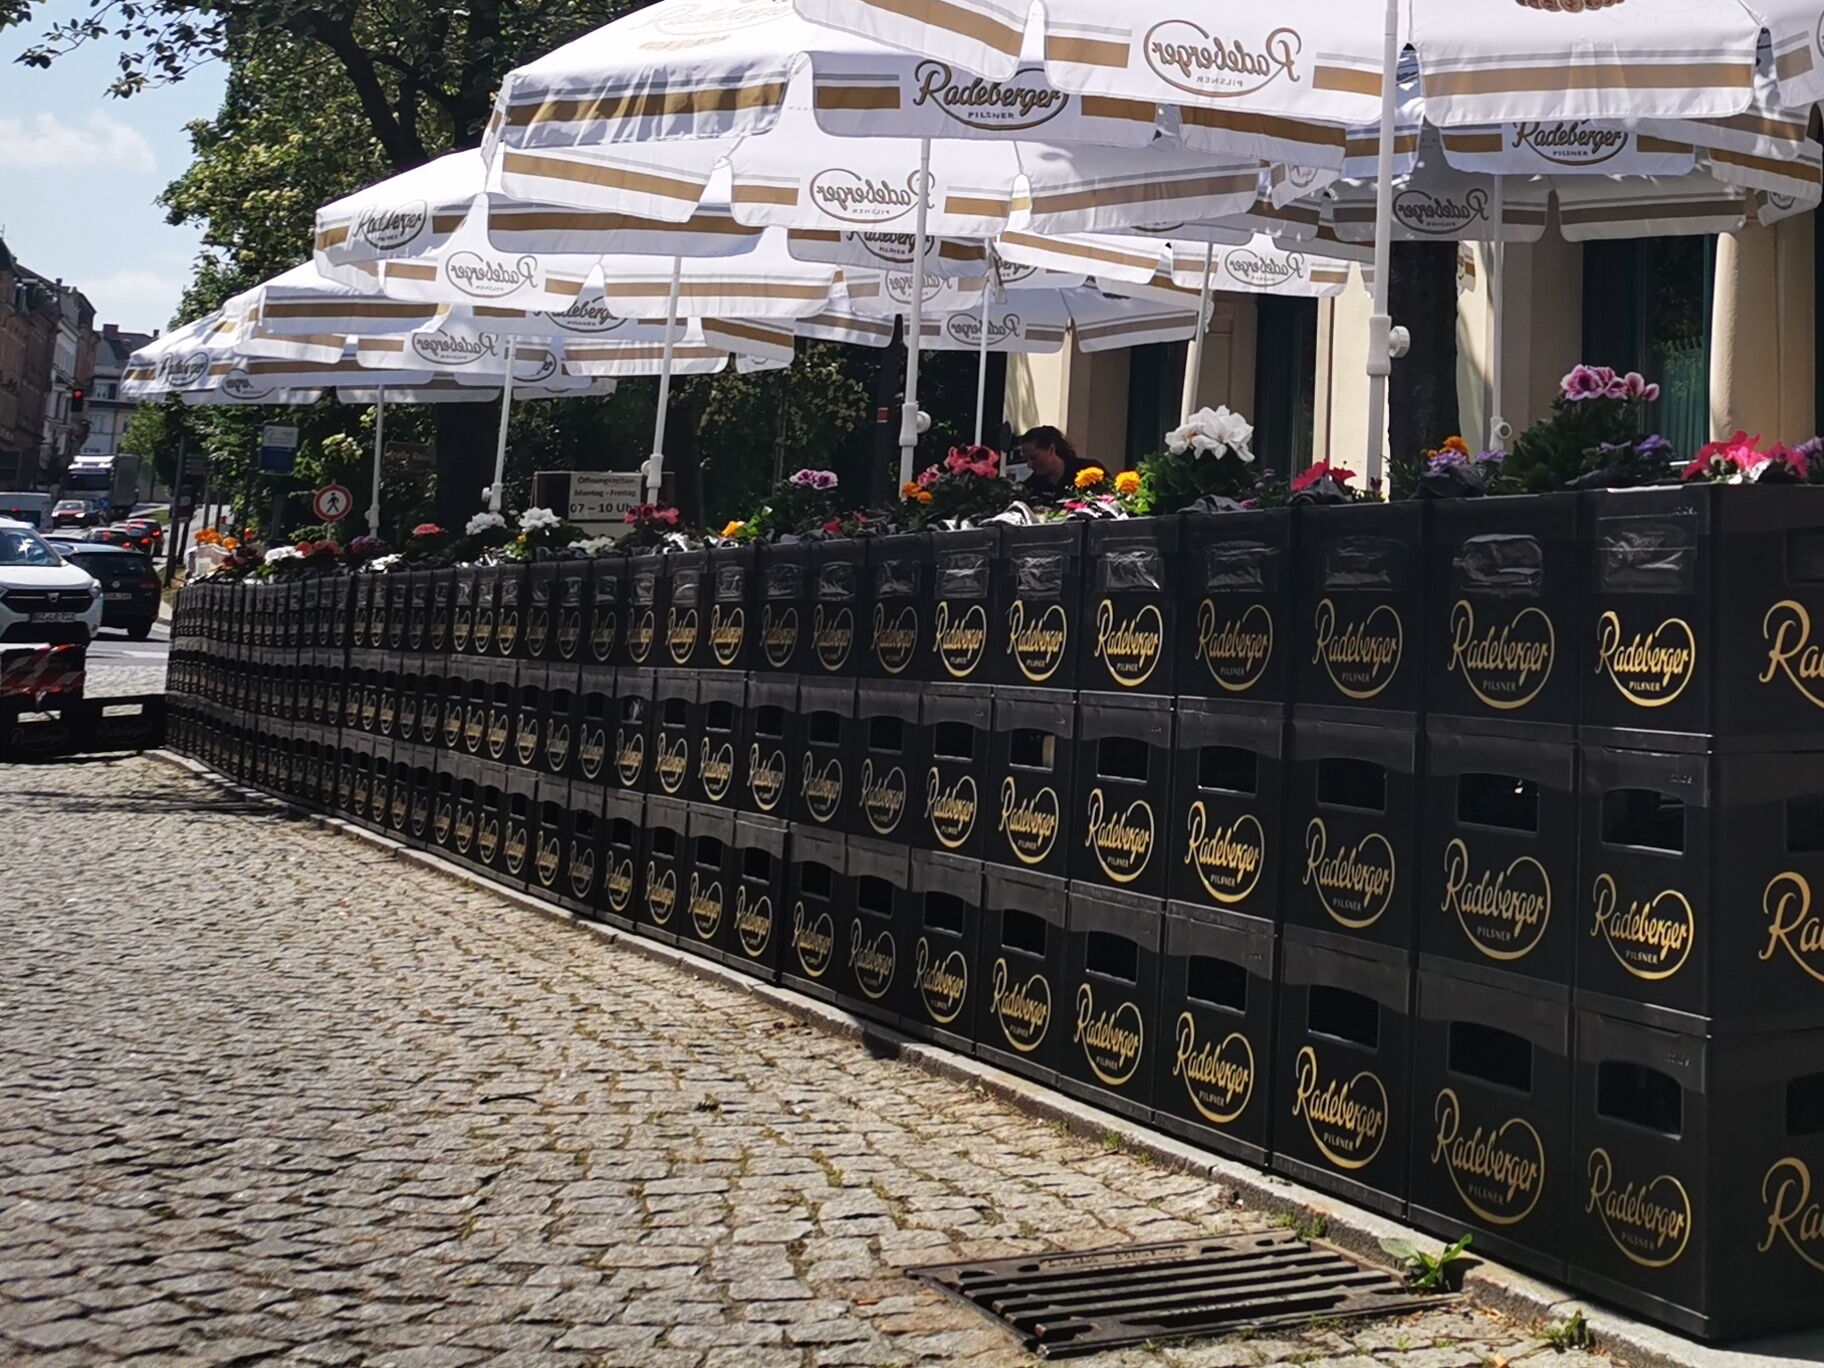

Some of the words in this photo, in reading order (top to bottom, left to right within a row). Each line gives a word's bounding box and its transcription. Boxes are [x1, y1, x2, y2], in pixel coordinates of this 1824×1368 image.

[913, 59, 1061, 117] Radeberger
[968, 111, 1015, 120] PILSNER
[570, 503, 585, 513] 07
[599, 503, 613, 513] 10
[1094, 599, 1160, 669] Radeberger
[1194, 598, 1269, 673] Radeberger
[1311, 598, 1398, 679] Radeberger
[1446, 598, 1549, 688] Radeberger
[1595, 610, 1690, 688] Radeberger
[1482, 680, 1516, 691] PILSNER
[1628, 681, 1660, 690] PILSNER
[1084, 788, 1151, 865] Radeberger
[1184, 800, 1261, 884] Radeberger
[1302, 817, 1390, 909] Radeberger
[1440, 837, 1545, 939] Radeberger
[1590, 872, 1688, 962] Radeberger
[1476, 925, 1511, 941] PILSNER
[1625, 949, 1658, 964] PILSNER
[1073, 983, 1140, 1068] Radeberger
[1172, 1011, 1250, 1105] Radeberger
[1291, 1045, 1383, 1149] Radeberger
[1430, 1087, 1539, 1203] Radeberger
[1585, 1147, 1686, 1249] Radeberger
